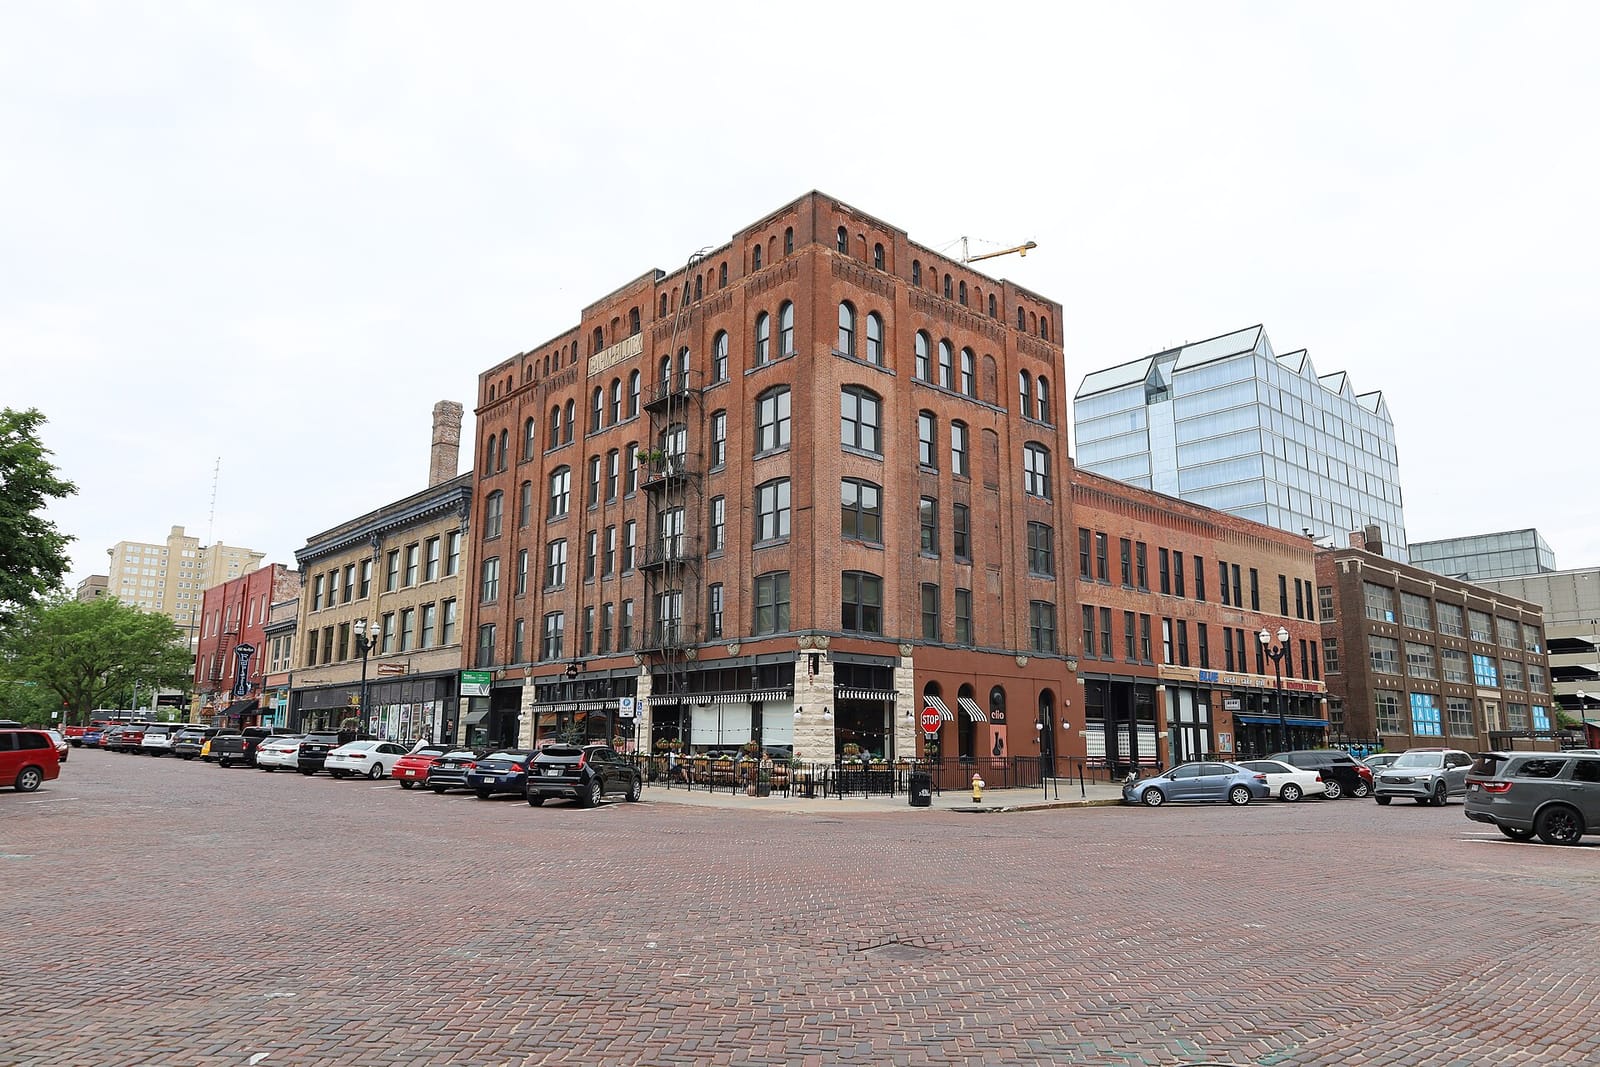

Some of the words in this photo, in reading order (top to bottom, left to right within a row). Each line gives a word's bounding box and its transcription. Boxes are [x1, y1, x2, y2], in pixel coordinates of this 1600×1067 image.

[1200, 670, 1218, 682] BLUE
[922, 714, 939, 725] STOP
[991, 710, 1004, 719] clio
